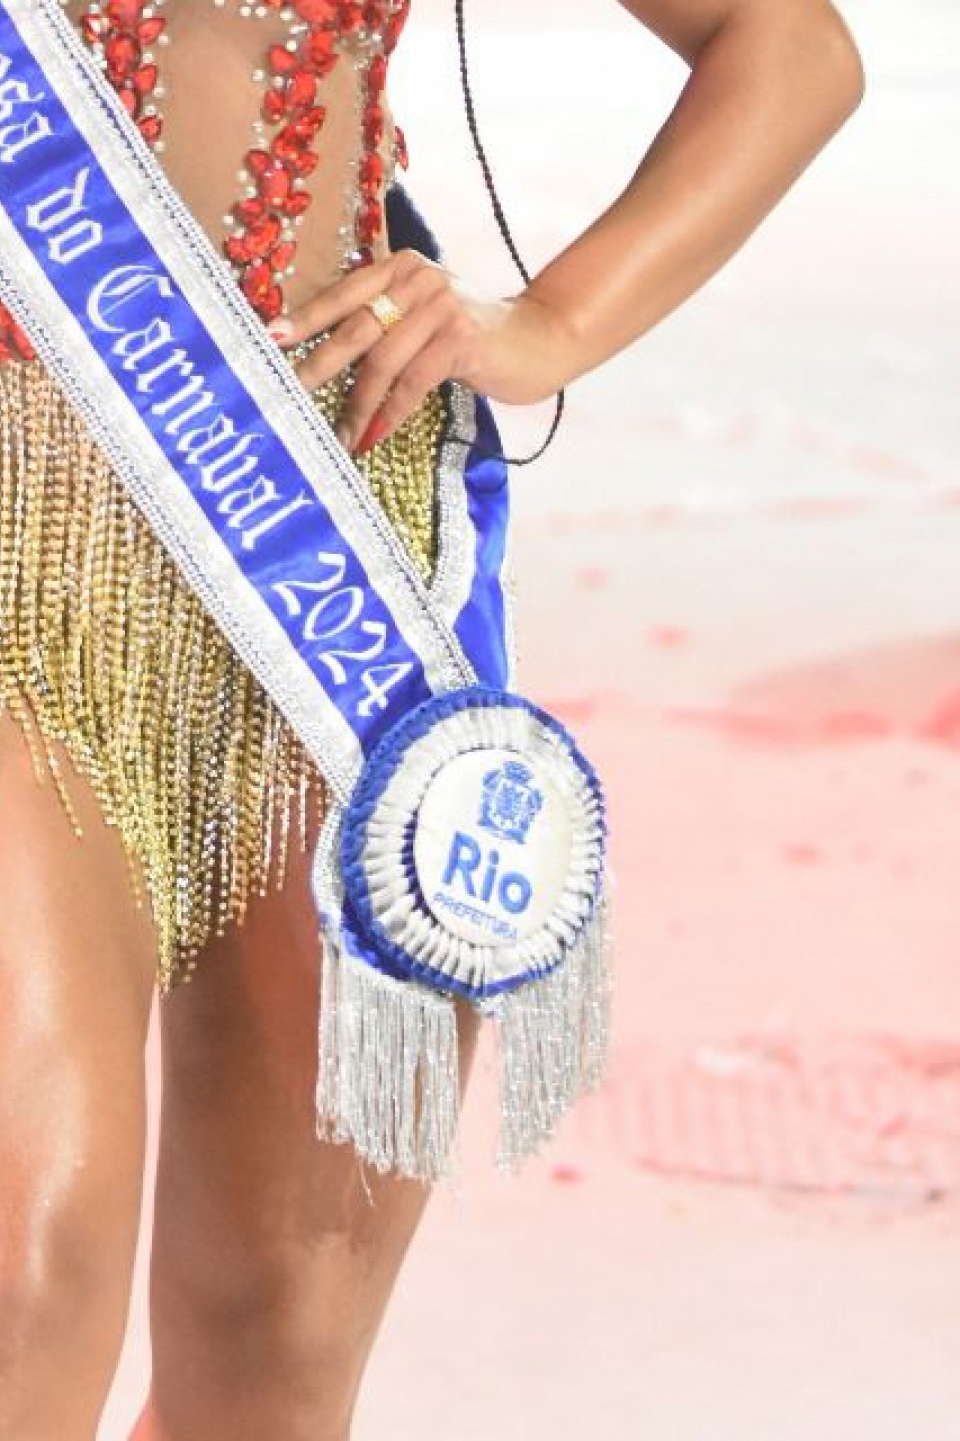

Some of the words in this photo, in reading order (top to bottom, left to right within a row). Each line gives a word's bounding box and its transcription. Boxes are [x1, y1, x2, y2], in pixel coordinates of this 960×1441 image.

[26, 166, 103, 265] do
[86, 265, 315, 550] Carnaval
[271, 551, 414, 716] 2024
[443, 831, 533, 914] Rio
